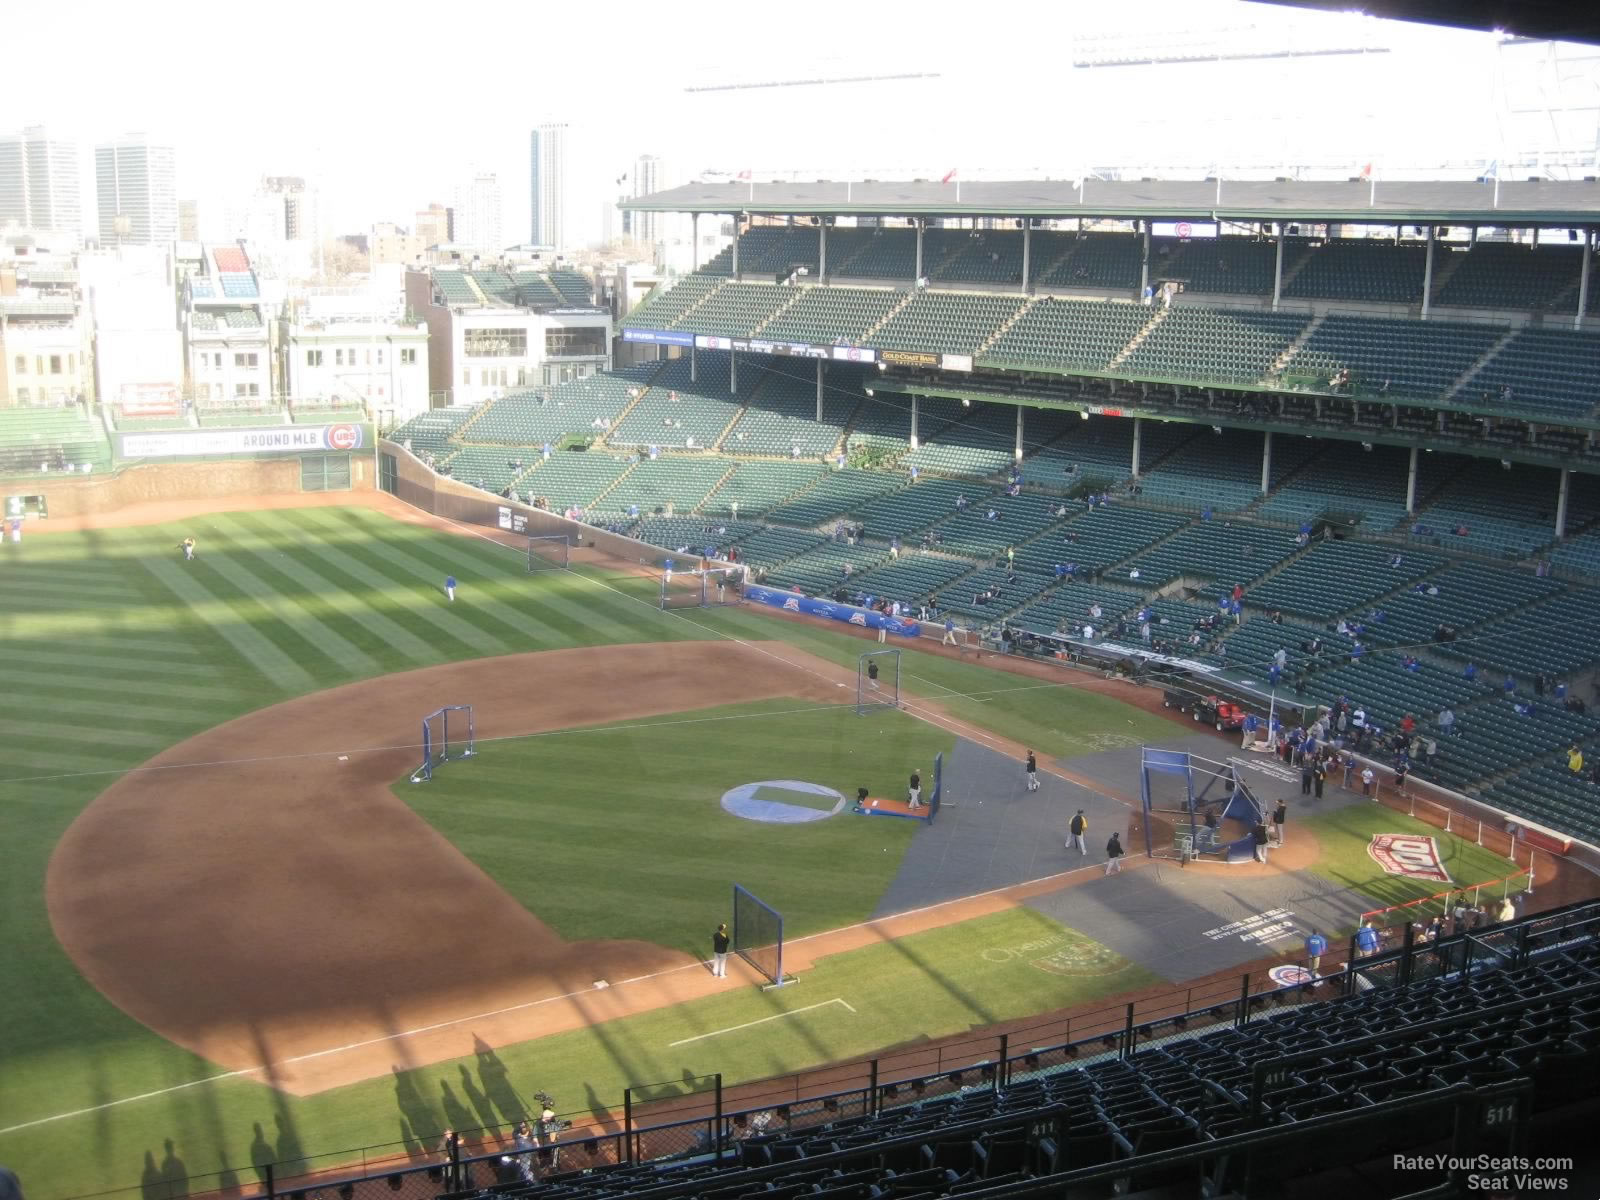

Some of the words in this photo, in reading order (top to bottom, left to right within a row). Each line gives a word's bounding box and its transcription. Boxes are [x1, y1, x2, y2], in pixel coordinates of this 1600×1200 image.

[882, 352, 900, 360] GOLD
[900, 353, 919, 361] COAST
[243, 433, 289, 448] AROUND
[293, 432, 317, 445] MLB
[1265, 1071, 1285, 1085] 411
[1486, 1105, 1513, 1124] 511
[1032, 1121, 1054, 1136] 411
